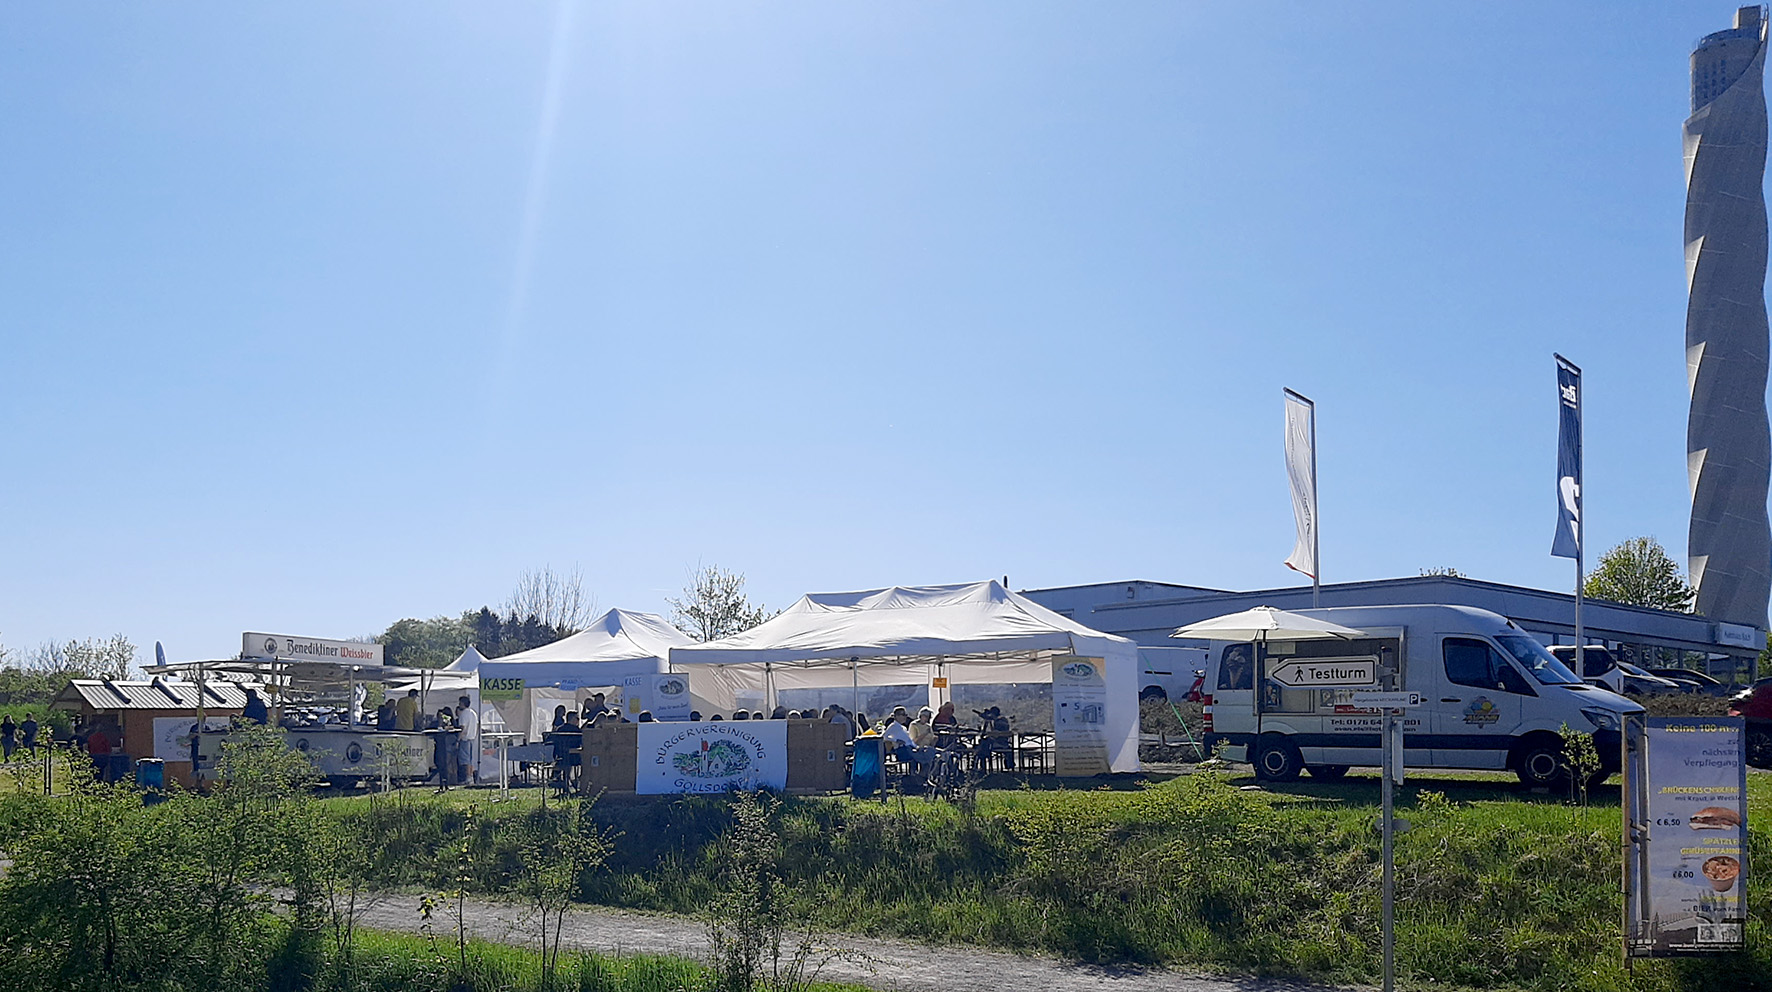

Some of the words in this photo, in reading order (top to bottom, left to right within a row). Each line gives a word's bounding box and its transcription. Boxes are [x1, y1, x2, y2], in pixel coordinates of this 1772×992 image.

[286, 639, 338, 656] Benediktiner
[340, 646, 374, 660] Weissbier
[1308, 667, 1367, 680] Testturm
[483, 678, 522, 691] KASSE
[624, 677, 642, 687] KASSE
[1665, 723, 1696, 733] Keine
[1698, 723, 1717, 733] 100
[655, 724, 766, 765] BÜRGERVEREINIGUNG
[673, 777, 746, 792] GÖLLSDOF
[1663, 818, 1681, 827] 6,50
